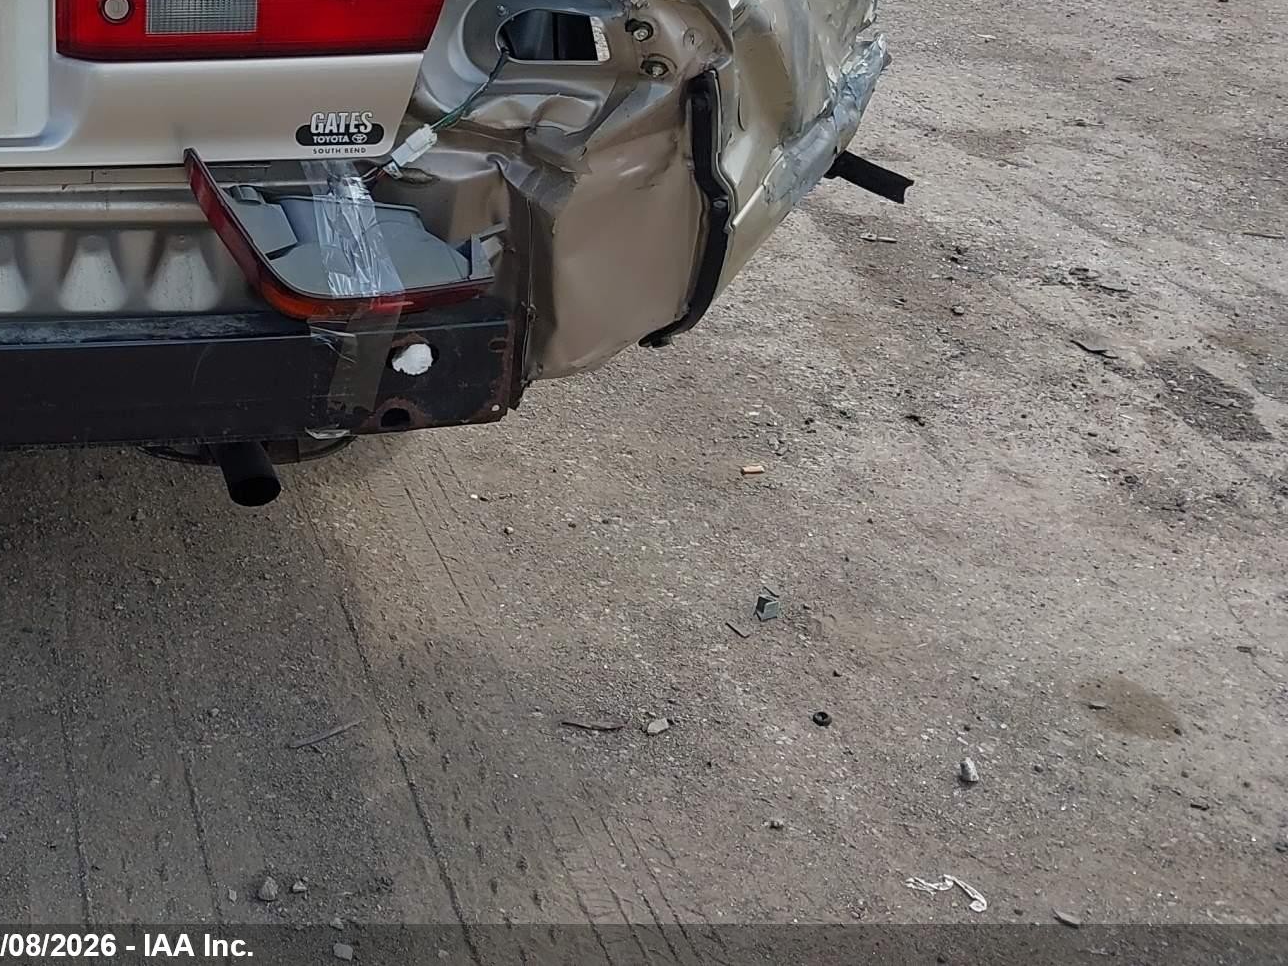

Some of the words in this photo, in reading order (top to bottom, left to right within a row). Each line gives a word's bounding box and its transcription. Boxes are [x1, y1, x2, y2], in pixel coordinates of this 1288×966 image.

[310, 111, 373, 134] GATES
[312, 135, 350, 144] TOYOTA
[312, 147, 341, 155] SOUTH
[344, 146, 367, 154] BEND
